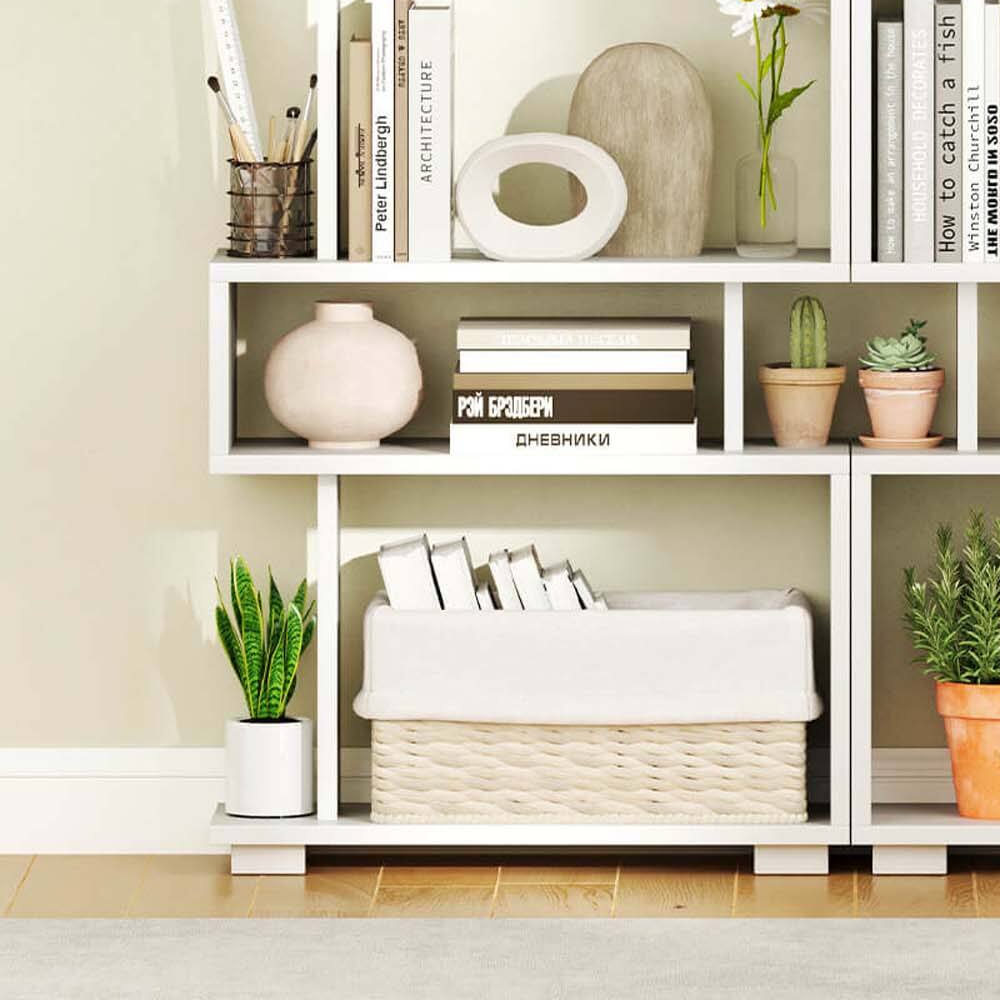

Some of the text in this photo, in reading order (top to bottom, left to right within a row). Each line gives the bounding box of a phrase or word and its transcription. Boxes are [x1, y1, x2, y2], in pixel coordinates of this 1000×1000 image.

[421, 60, 432, 183] ARCHITECTURE
[886, 63, 895, 79] the
[912, 29, 928, 222] HOUSEHOLD DECORATES
[375, 116, 391, 232] Peter Lindbergh
[939, 16, 956, 252] How to catch a fish
[968, 85, 980, 251] Winston Churchill
[458, 392, 553, 419] РЭЙ БРЭДБЕРИ
[516, 434, 610, 446] ДНЕВНИКИ
